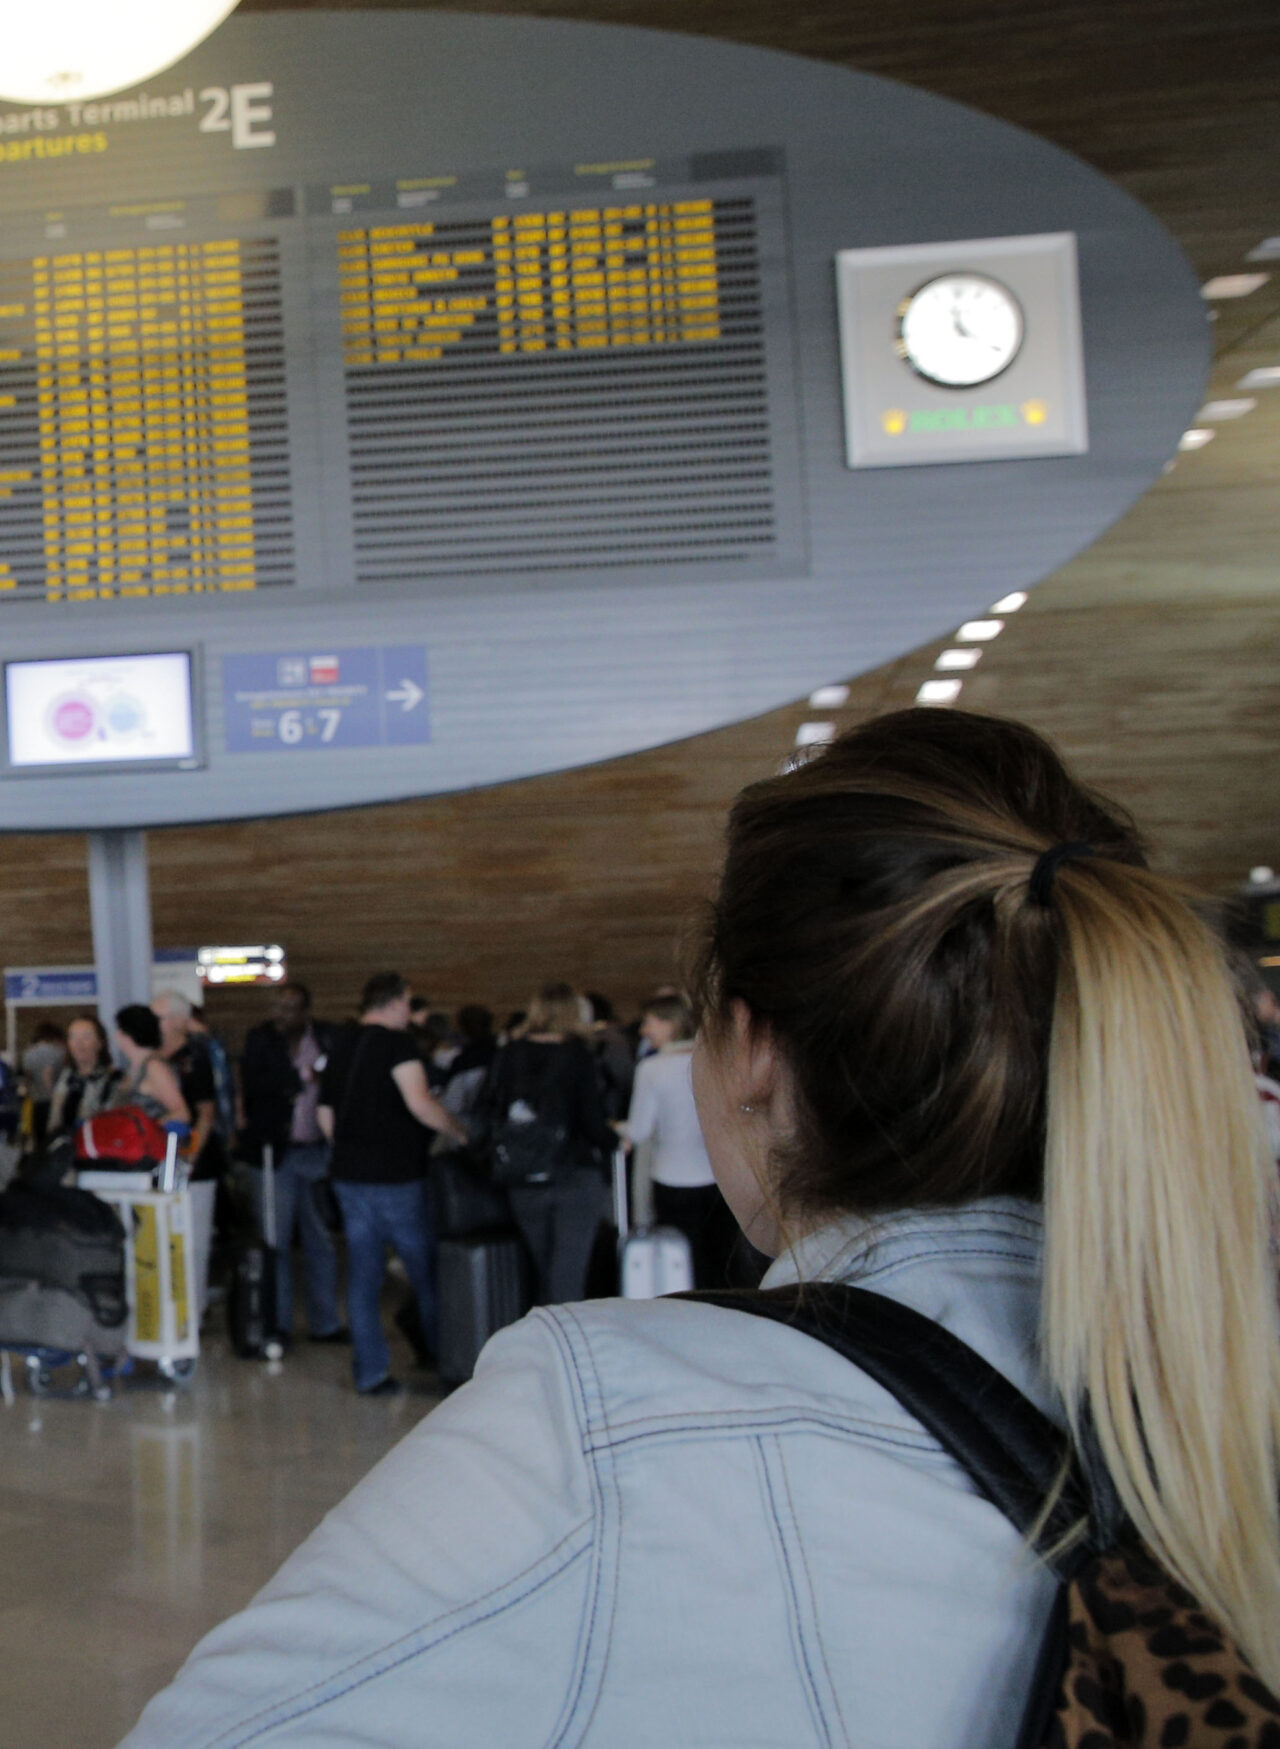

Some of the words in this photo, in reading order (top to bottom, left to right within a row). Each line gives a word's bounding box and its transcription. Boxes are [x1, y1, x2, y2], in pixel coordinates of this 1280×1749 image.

[65, 88, 196, 127] Terminal
[198, 82, 276, 150] 2E
[278, 709, 304, 744] 6
[317, 708, 341, 742] 7
